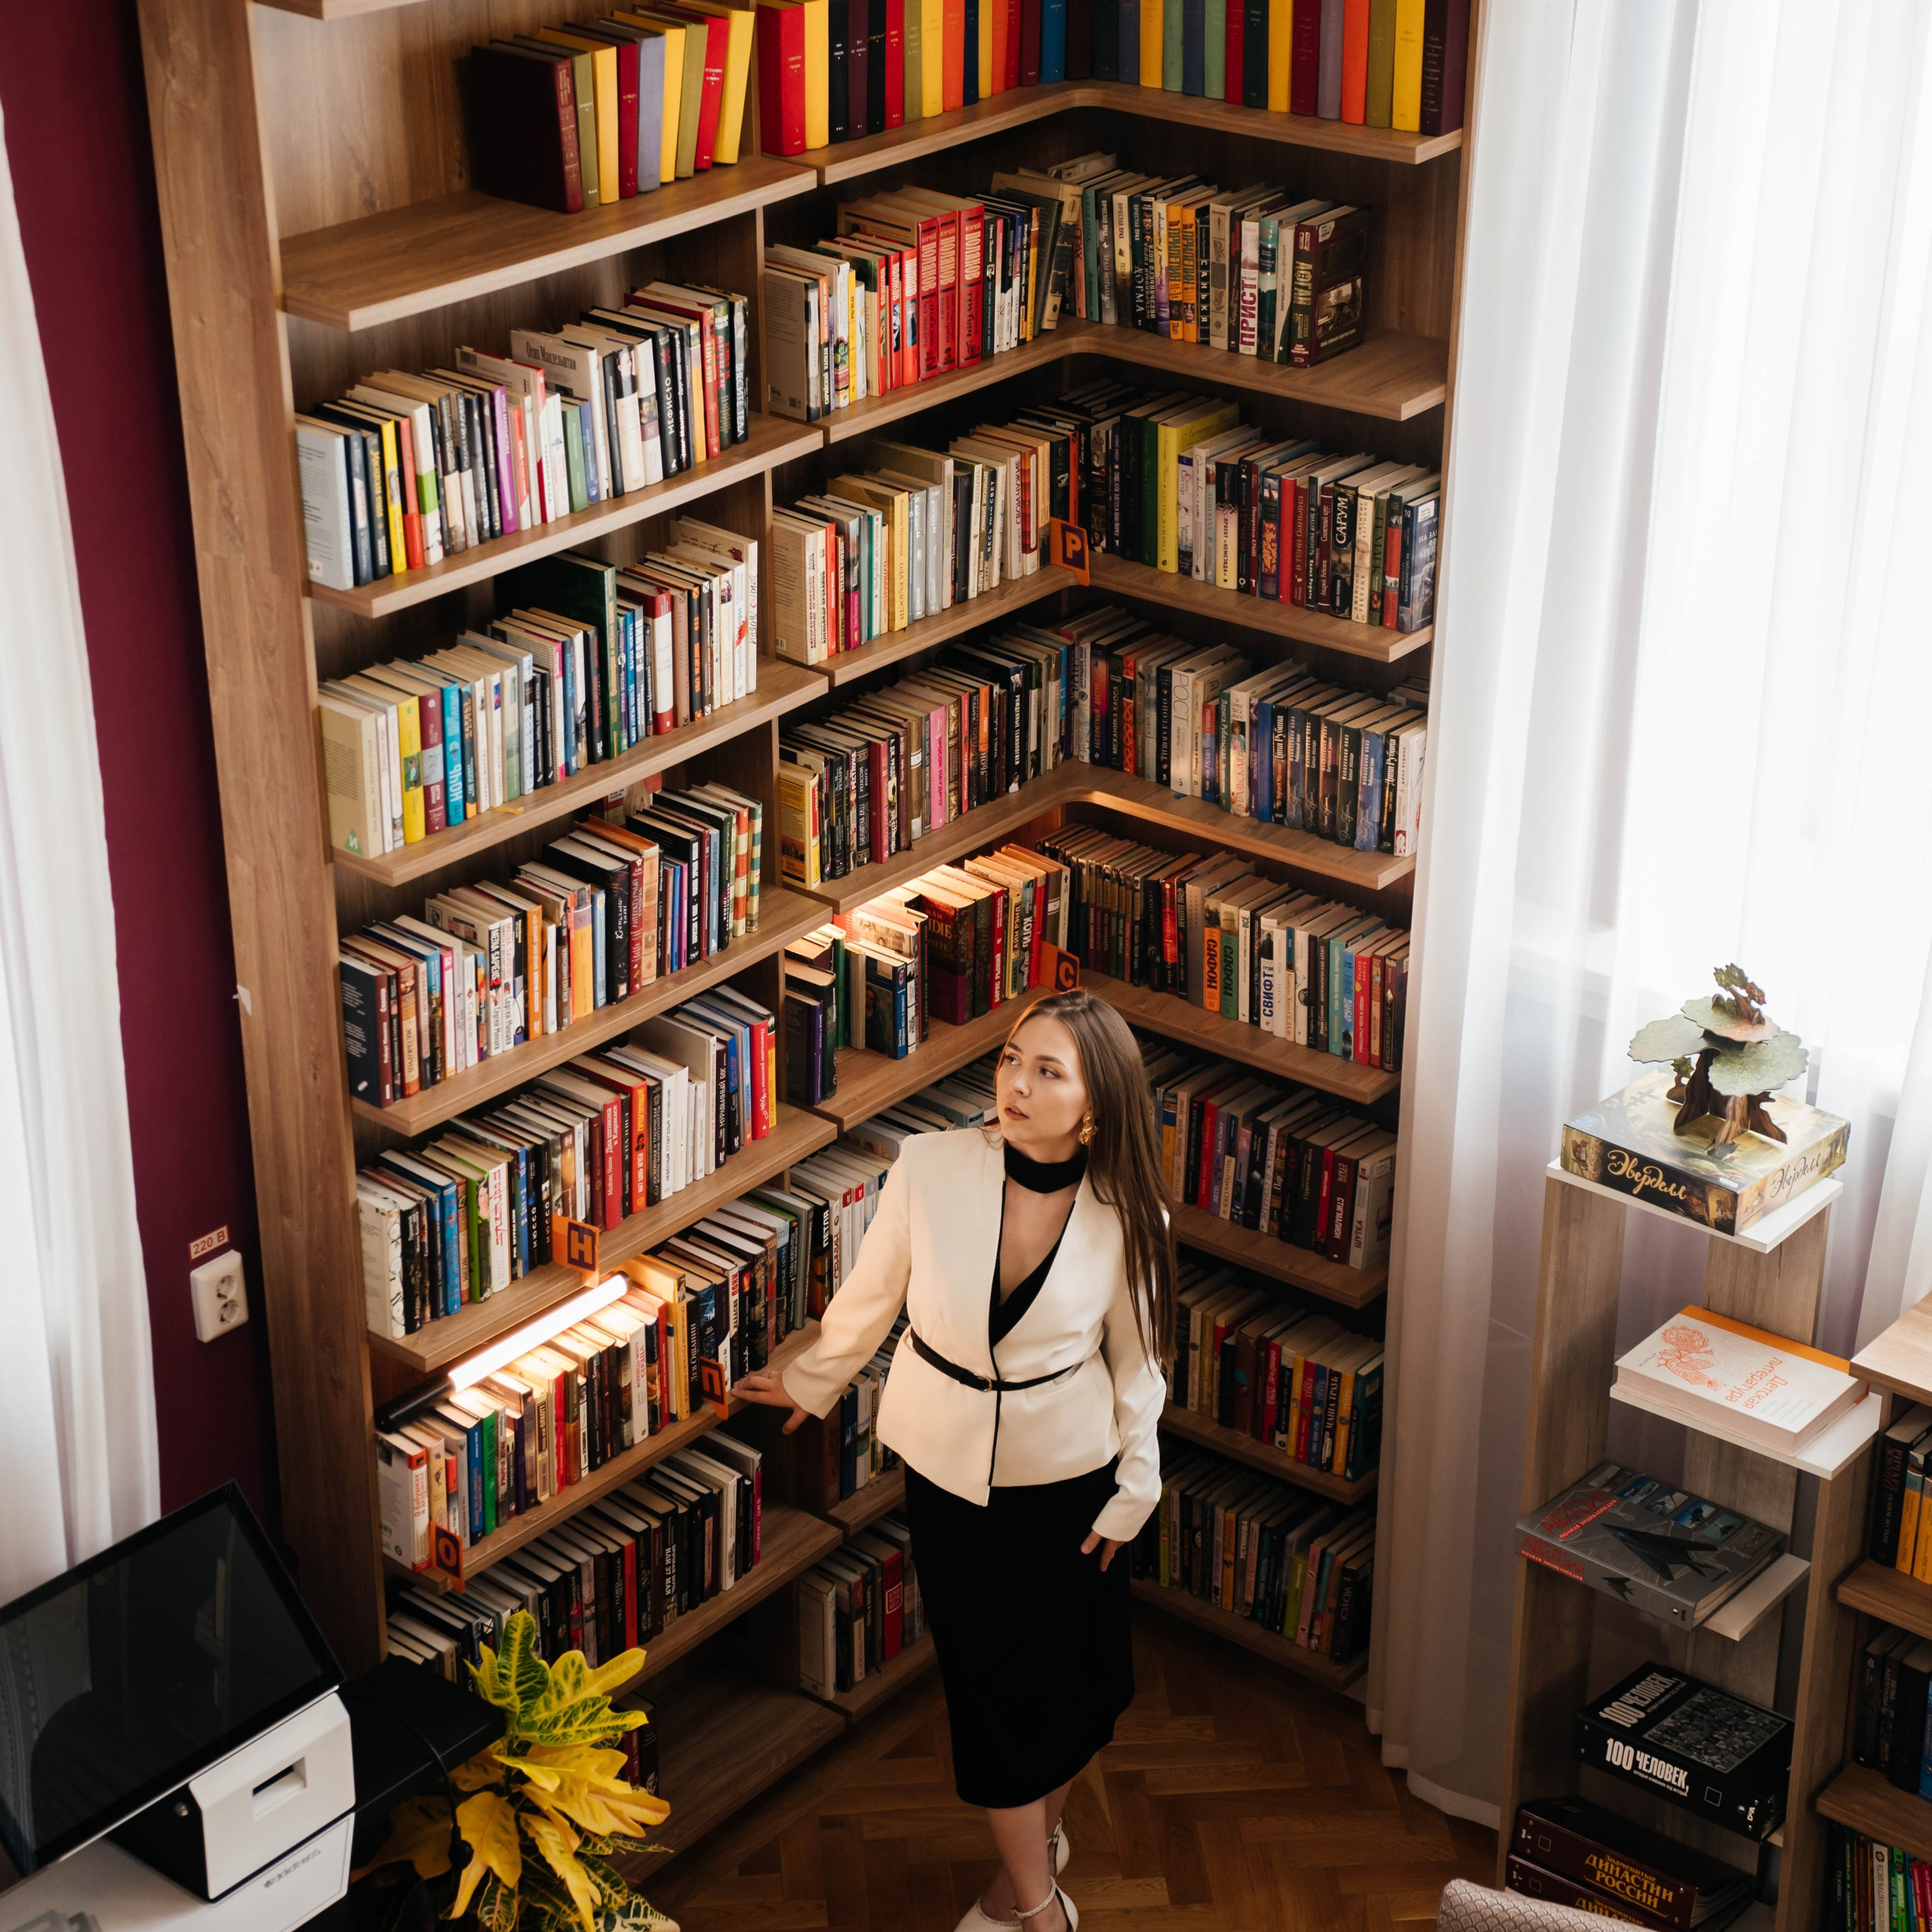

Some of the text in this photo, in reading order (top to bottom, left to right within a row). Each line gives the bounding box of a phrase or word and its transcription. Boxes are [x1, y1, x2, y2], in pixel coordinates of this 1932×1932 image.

[921, 242, 937, 291] ПОЛЯКОВ
[940, 236, 955, 285] ПОЛЯКОВ
[964, 231, 981, 280] ПОЛЯКОВ
[1240, 282, 1257, 346] ПРИСТ
[450, 764, 463, 801] НОЧЬ
[1262, 971, 1274, 1017] СВИФТ
[1607, 1149, 1687, 1201] Эверделл
[193, 1238, 213, 1255] 220
[1725, 1356, 1783, 1402] литература
[1742, 1374, 1788, 1410] Детская
[1598, 1701, 1647, 1728] 100
[1605, 1738, 1635, 1771] 100
[1584, 1854, 1674, 1903] ДИНАСТИИ
[1595, 1870, 1658, 1909] РОССИИ
[1604, 1854, 1657, 1881] Знаменитые
